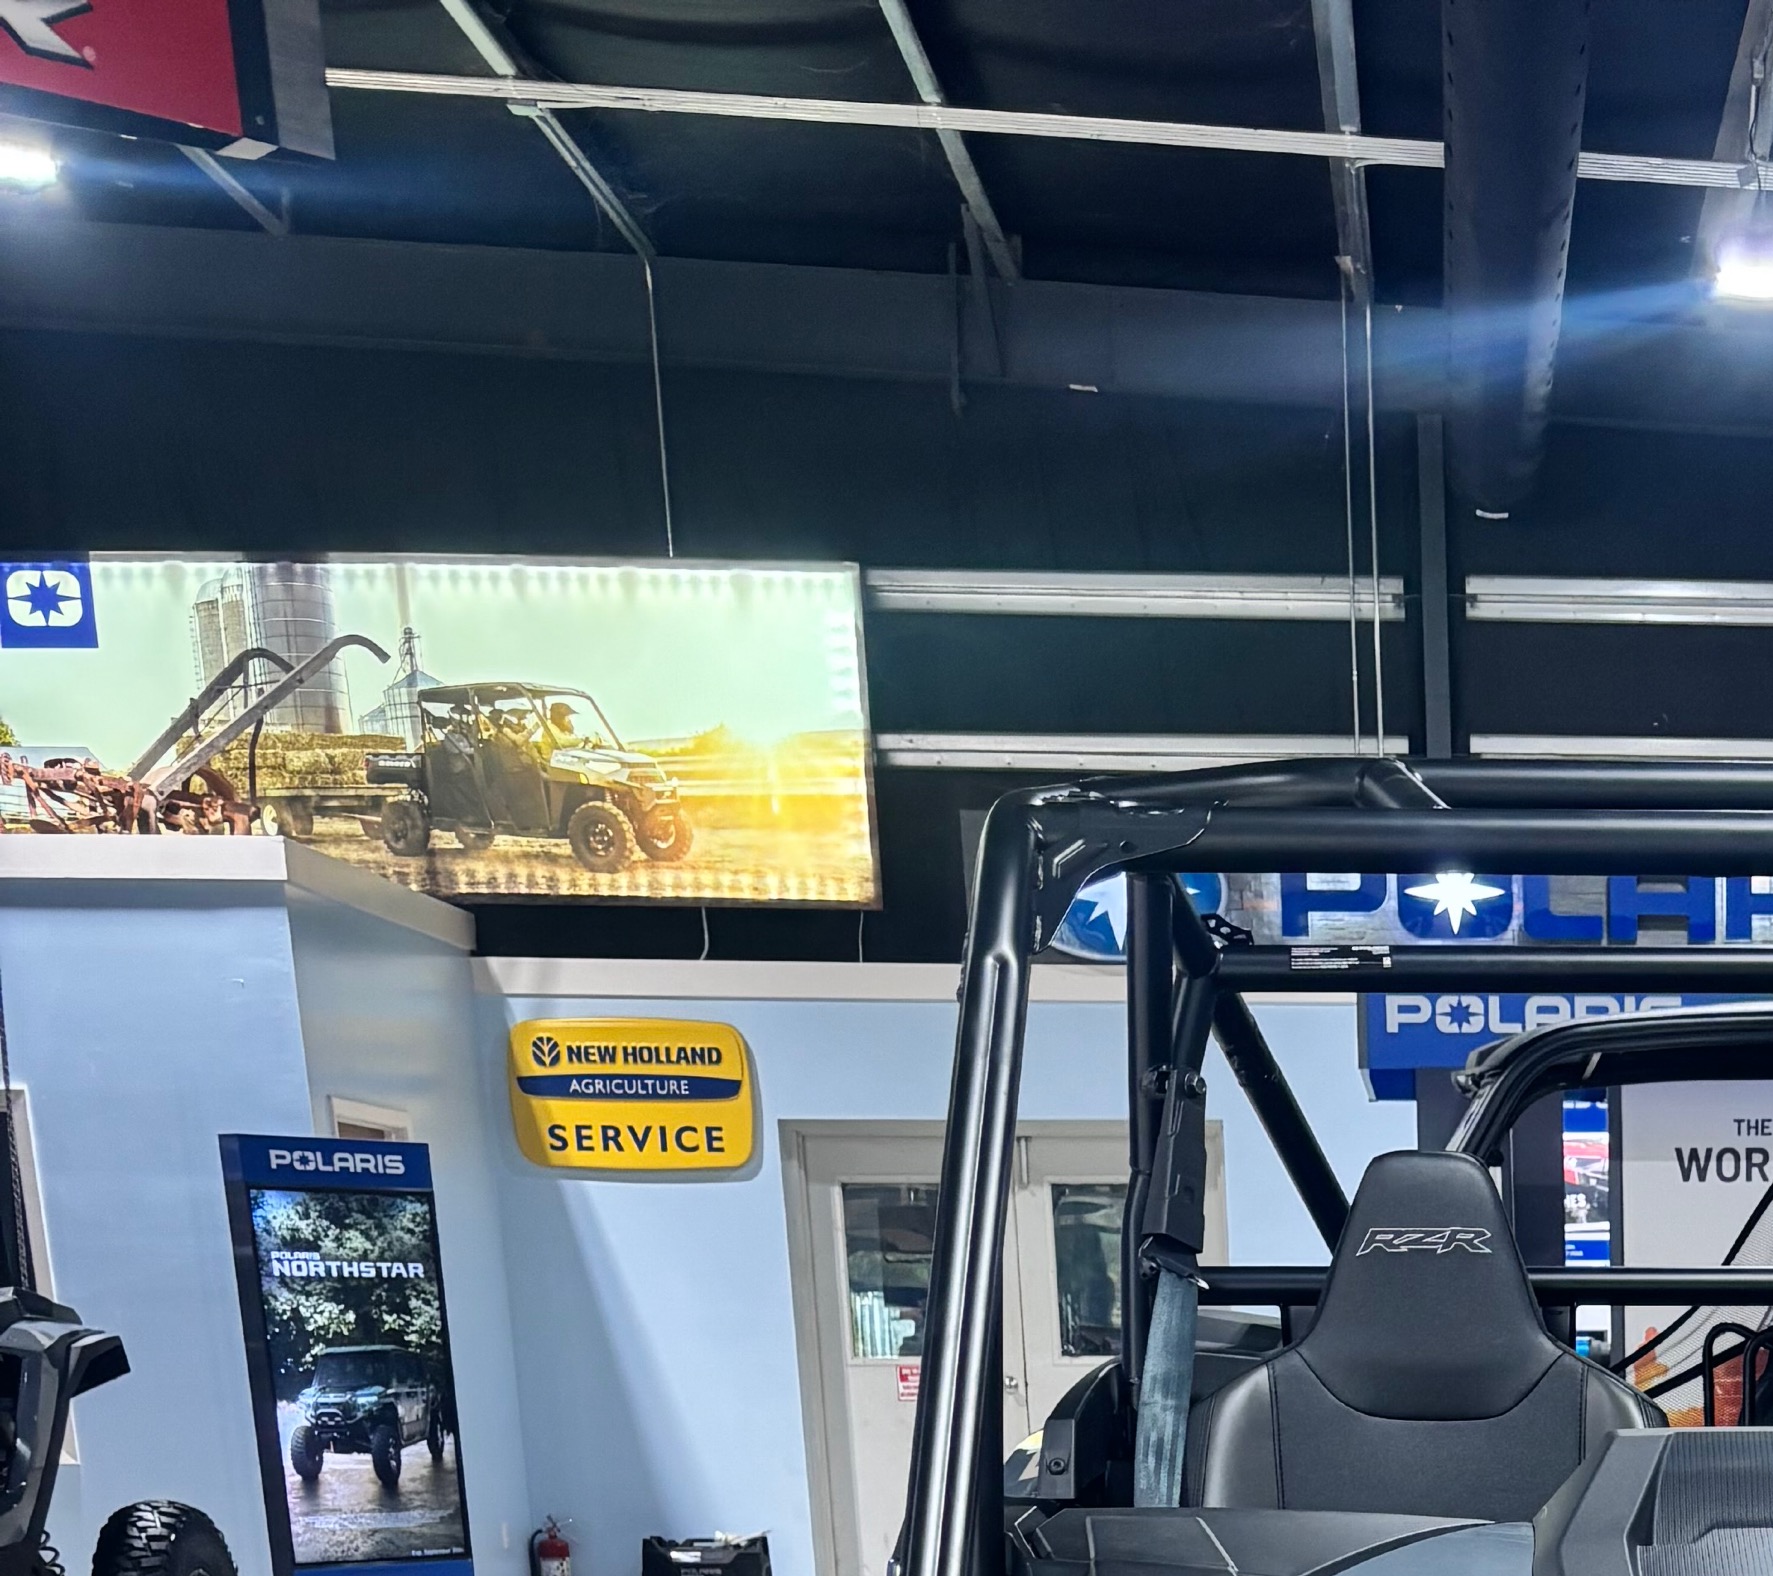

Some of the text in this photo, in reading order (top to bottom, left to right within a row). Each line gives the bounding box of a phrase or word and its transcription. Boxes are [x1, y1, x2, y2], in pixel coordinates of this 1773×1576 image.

[566, 1044, 723, 1066] NEW HOLLAND
[569, 1078, 690, 1095] AGRICULTURE
[1733, 1118, 1773, 1136] THE
[547, 1123, 727, 1153] SERVICE
[268, 1148, 406, 1176] POLARIS
[1355, 1226, 1493, 1257] RZR
[270, 1250, 321, 1261] POLARIS
[271, 1259, 425, 1279] NORTHSTAR
